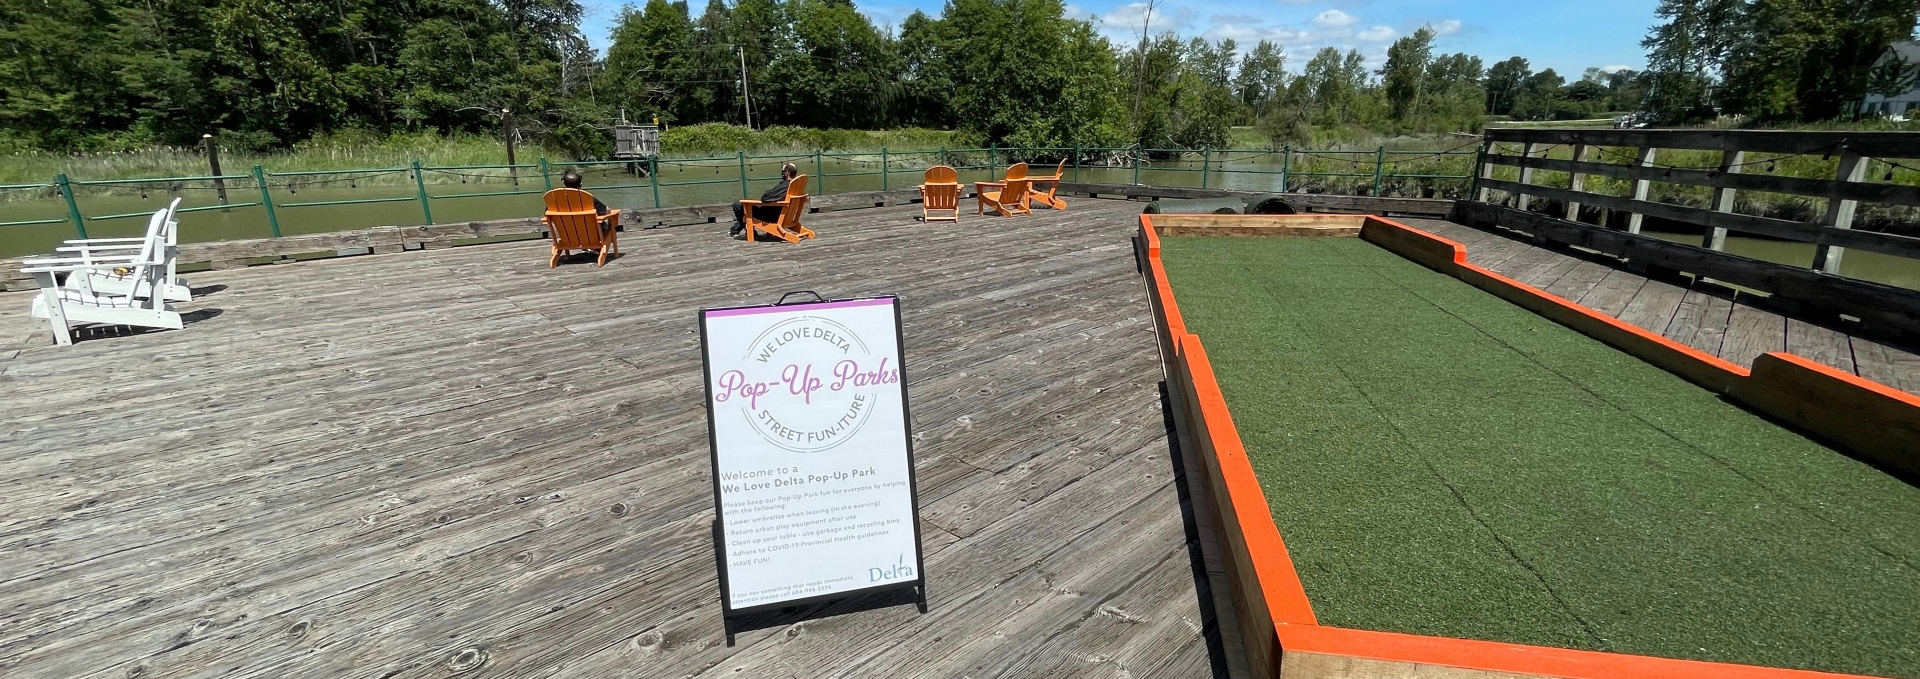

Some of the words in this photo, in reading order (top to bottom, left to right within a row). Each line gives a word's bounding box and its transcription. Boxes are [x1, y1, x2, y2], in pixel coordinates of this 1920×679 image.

[757, 344, 777, 363] WE
[775, 327, 810, 346] LOVE
[814, 327, 850, 354] DELTA
[715, 364, 823, 410] Pop-Up
[830, 357, 898, 391] Parks
[758, 410, 804, 442] STREET
[808, 394, 865, 442] FUN-ITURE
[721, 470, 773, 481] Welcome
[722, 484, 740, 493] We
[744, 482, 770, 491] Love
[775, 477, 804, 487] Delta
[808, 471, 848, 483] Pop-Up
[852, 467, 876, 477] Park
[752, 514, 784, 522] umbrellas
[792, 518, 826, 528] equipment
[732, 538, 753, 546] Clean
[816, 527, 842, 536] garbage
[768, 542, 799, 552] COVID-19
[800, 538, 832, 547] Provincial
[857, 530, 889, 540] guidelines
[868, 552, 913, 582] Delta
[761, 585, 791, 594] something
